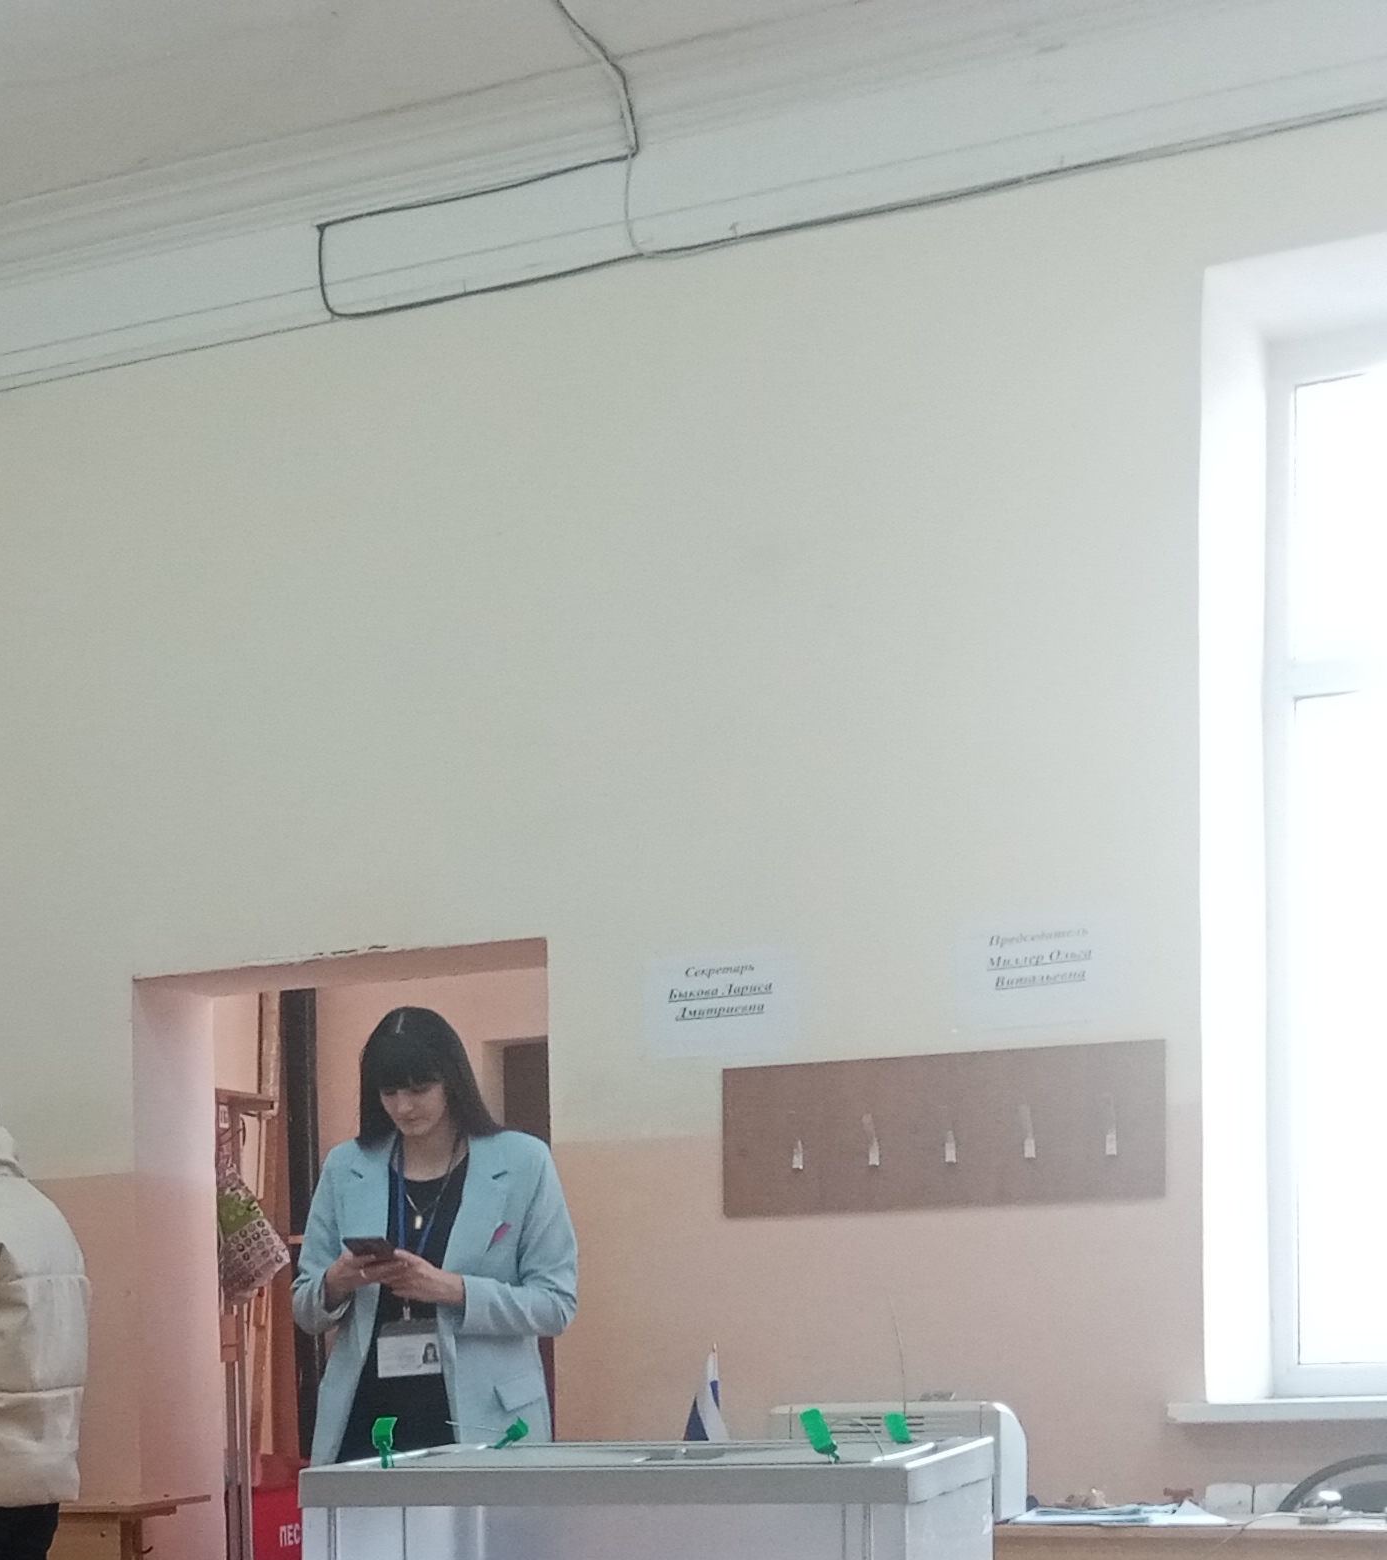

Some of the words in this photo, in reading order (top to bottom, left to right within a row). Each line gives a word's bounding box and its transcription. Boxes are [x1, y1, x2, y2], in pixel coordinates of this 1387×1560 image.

[684, 964, 755, 979] Секретарь
[669, 988, 719, 1000] Быкова
[721, 982, 772, 996] Лариса
[675, 1003, 765, 1020] Дмитриевна
[279, 1522, 300, 1547] ПЕС
